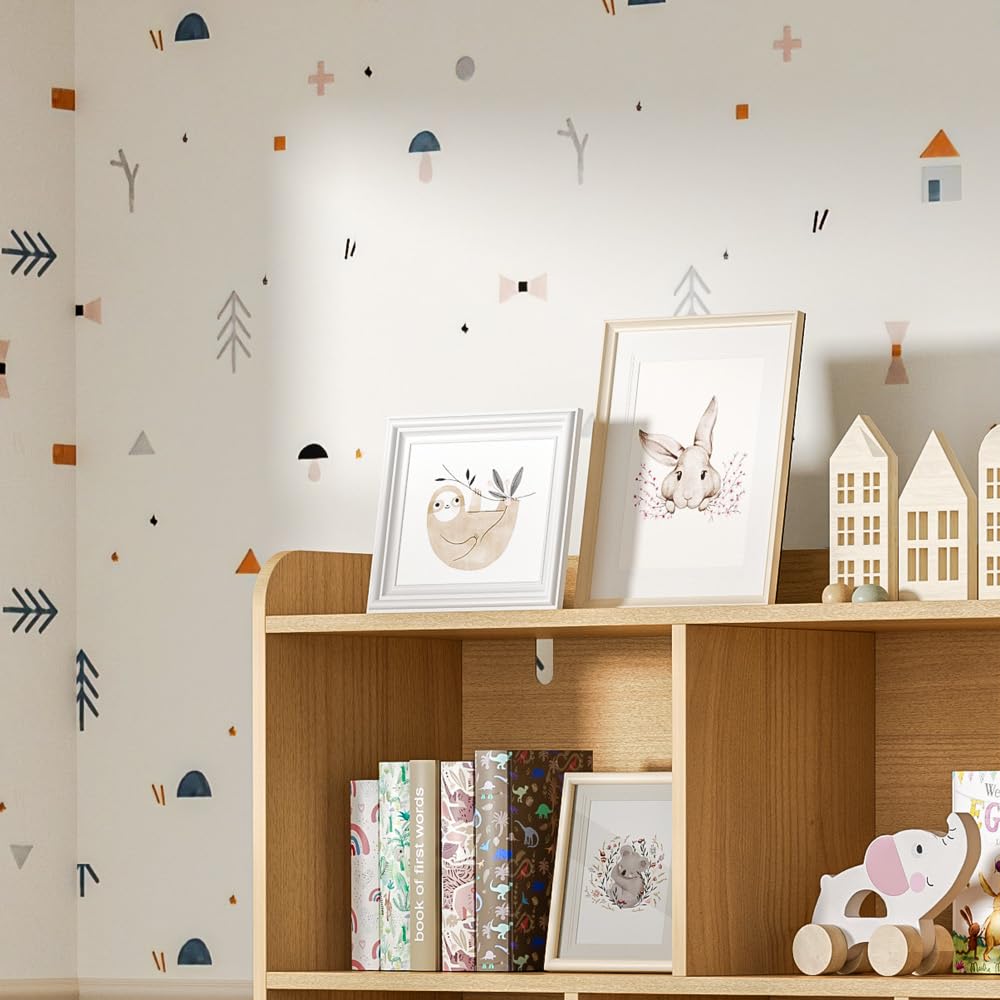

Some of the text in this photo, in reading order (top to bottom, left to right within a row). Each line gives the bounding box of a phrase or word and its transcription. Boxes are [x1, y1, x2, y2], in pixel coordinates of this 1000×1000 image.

[414, 786, 425, 942] book of first words
